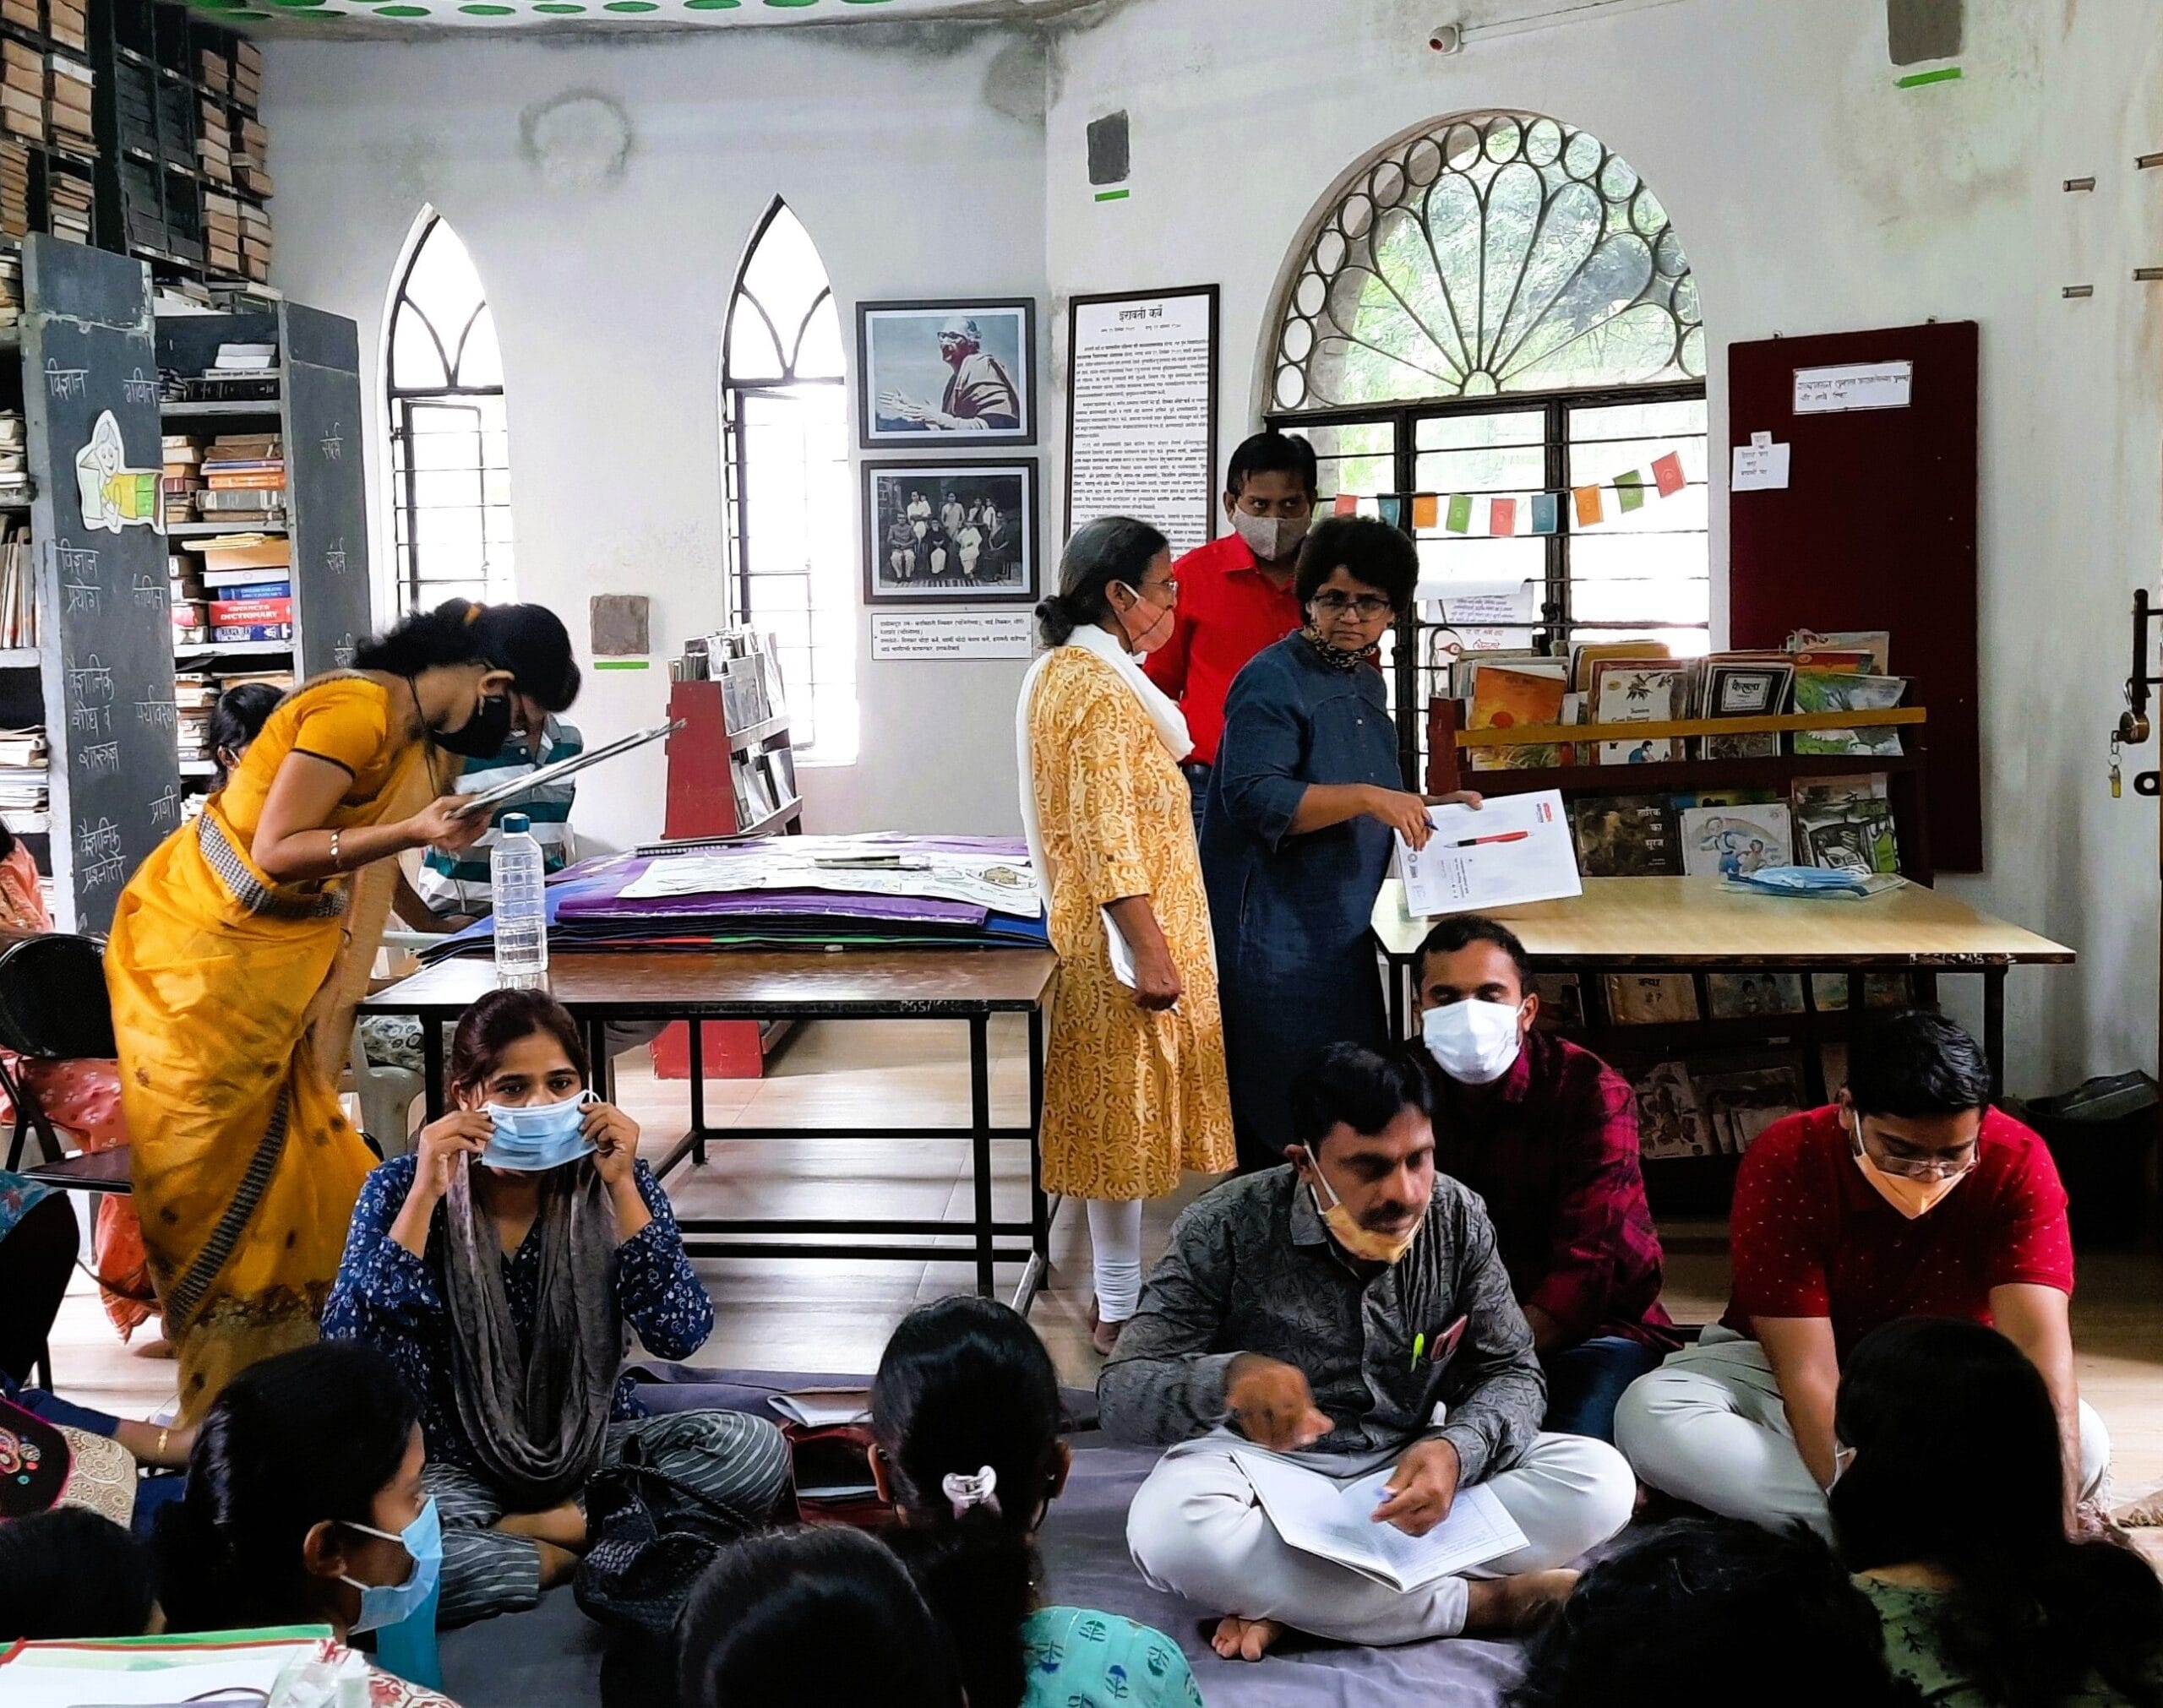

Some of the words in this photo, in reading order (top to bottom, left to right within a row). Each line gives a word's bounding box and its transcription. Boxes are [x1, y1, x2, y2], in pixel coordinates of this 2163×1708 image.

[45, 357, 89, 400] विज्ञान
[123, 367, 161, 407] गणित
[55, 538, 100, 579] विज्ञान
[64, 576, 101, 617] प्रयोग
[220, 611, 278, 621] DICTIONARY
[149, 785, 177, 825] प्राणी
